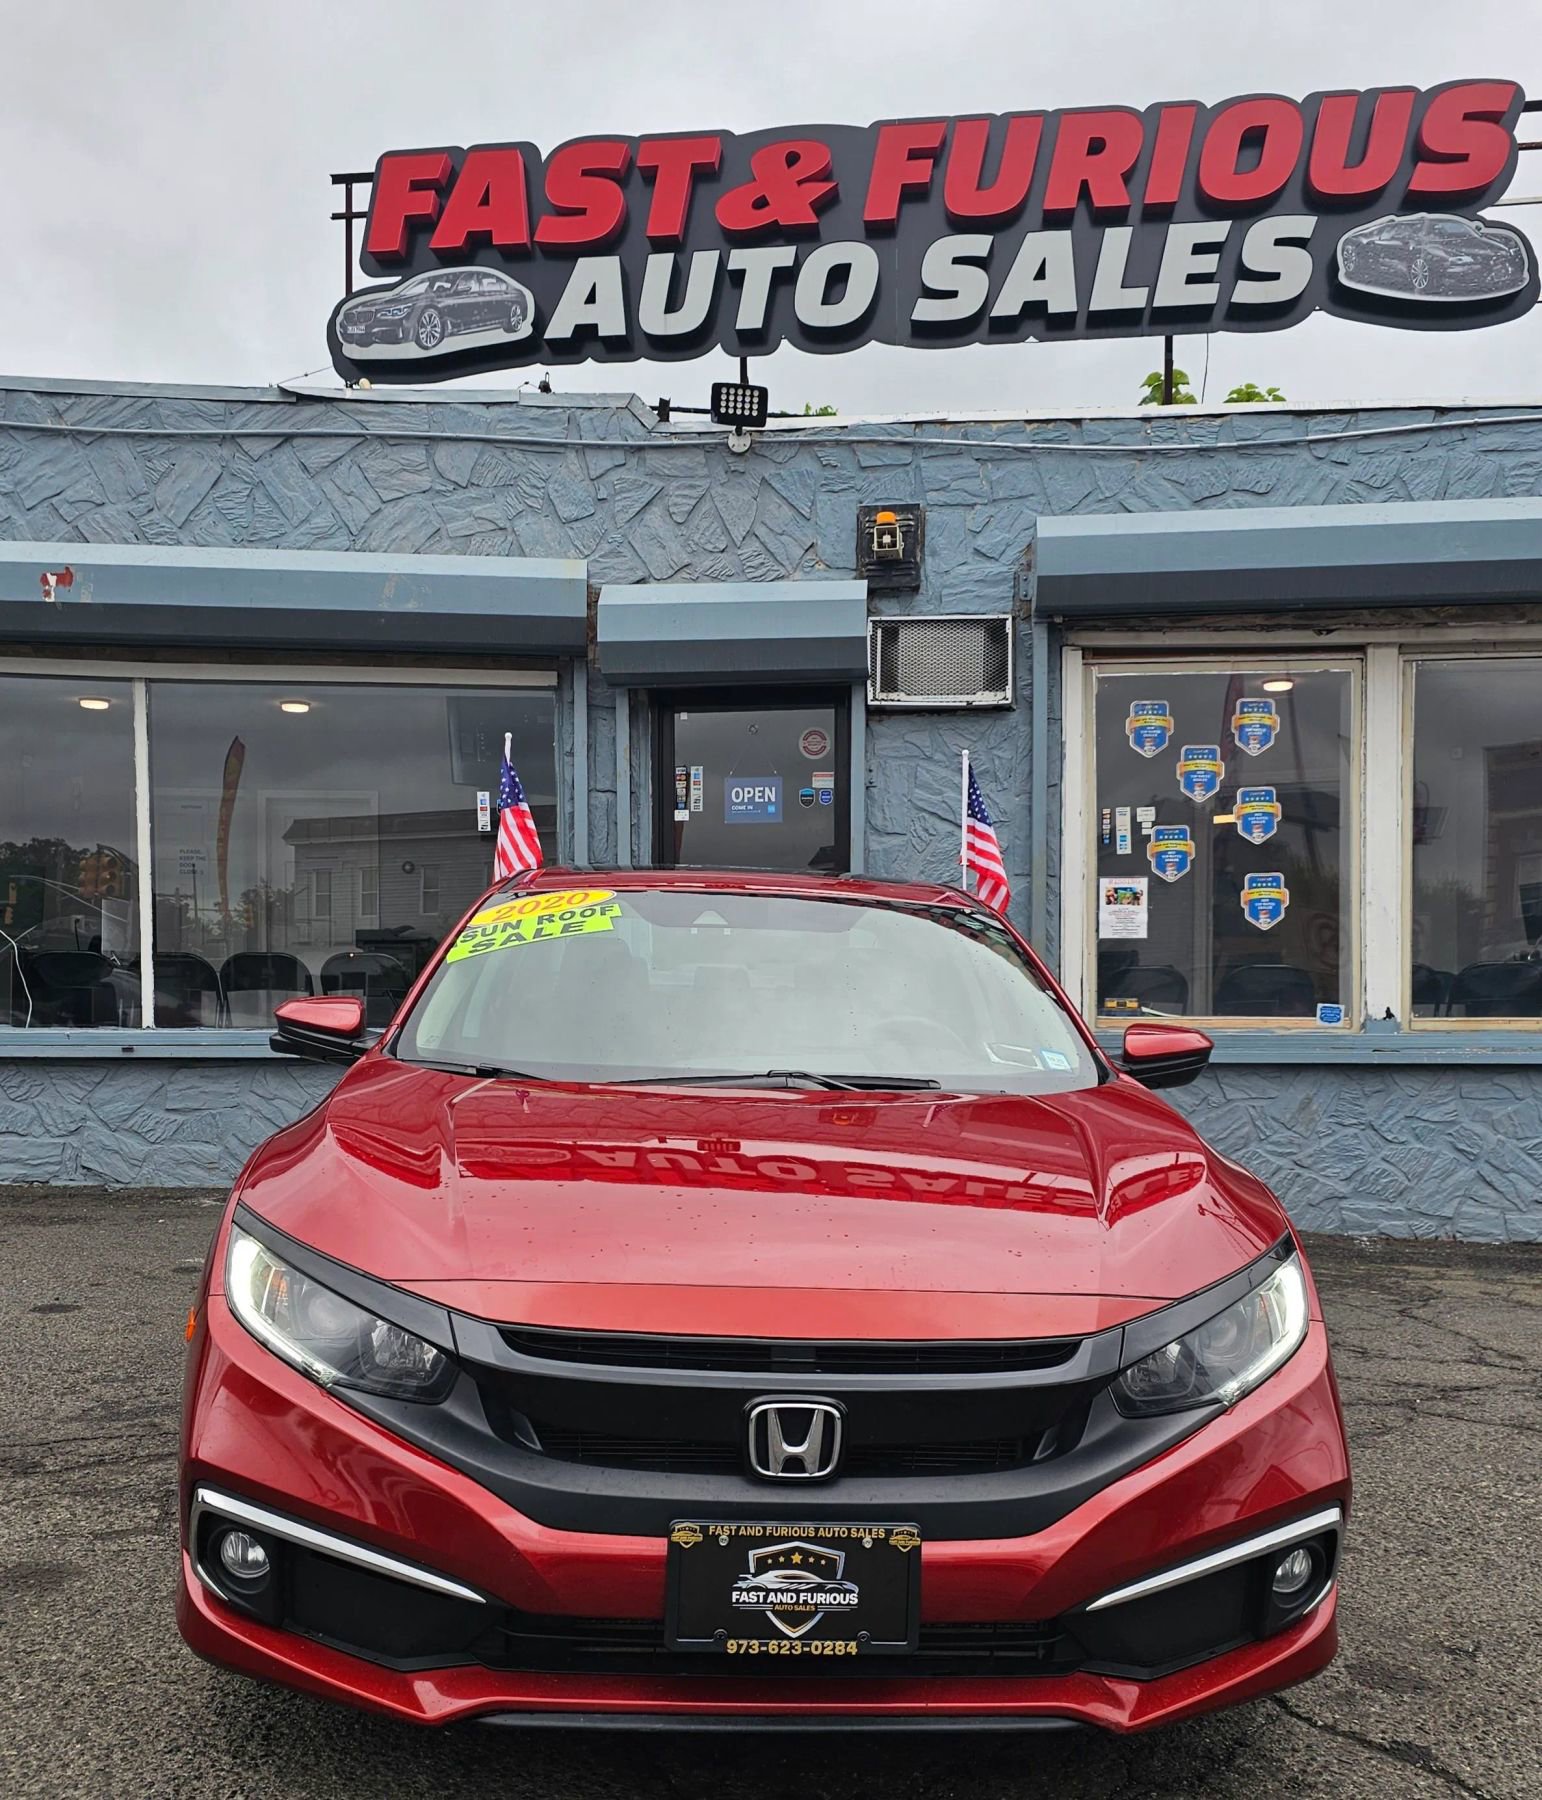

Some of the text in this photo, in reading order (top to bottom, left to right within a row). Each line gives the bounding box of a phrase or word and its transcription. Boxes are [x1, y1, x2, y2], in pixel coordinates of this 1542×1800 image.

[367, 82, 1519, 257] FAST & FURIOUS
[543, 214, 1319, 339] AUTO SALES
[731, 786, 776, 803] OPEN
[491, 892, 590, 922] 2020
[459, 904, 615, 943] SUN ROOF
[468, 920, 588, 953] SALE
[708, 1525, 886, 1539] FAST AND FURIOUS AUTO SALES
[731, 1591, 859, 1605] FAST AND FURIOUS
[726, 1639, 858, 1656] 973-623-0284
